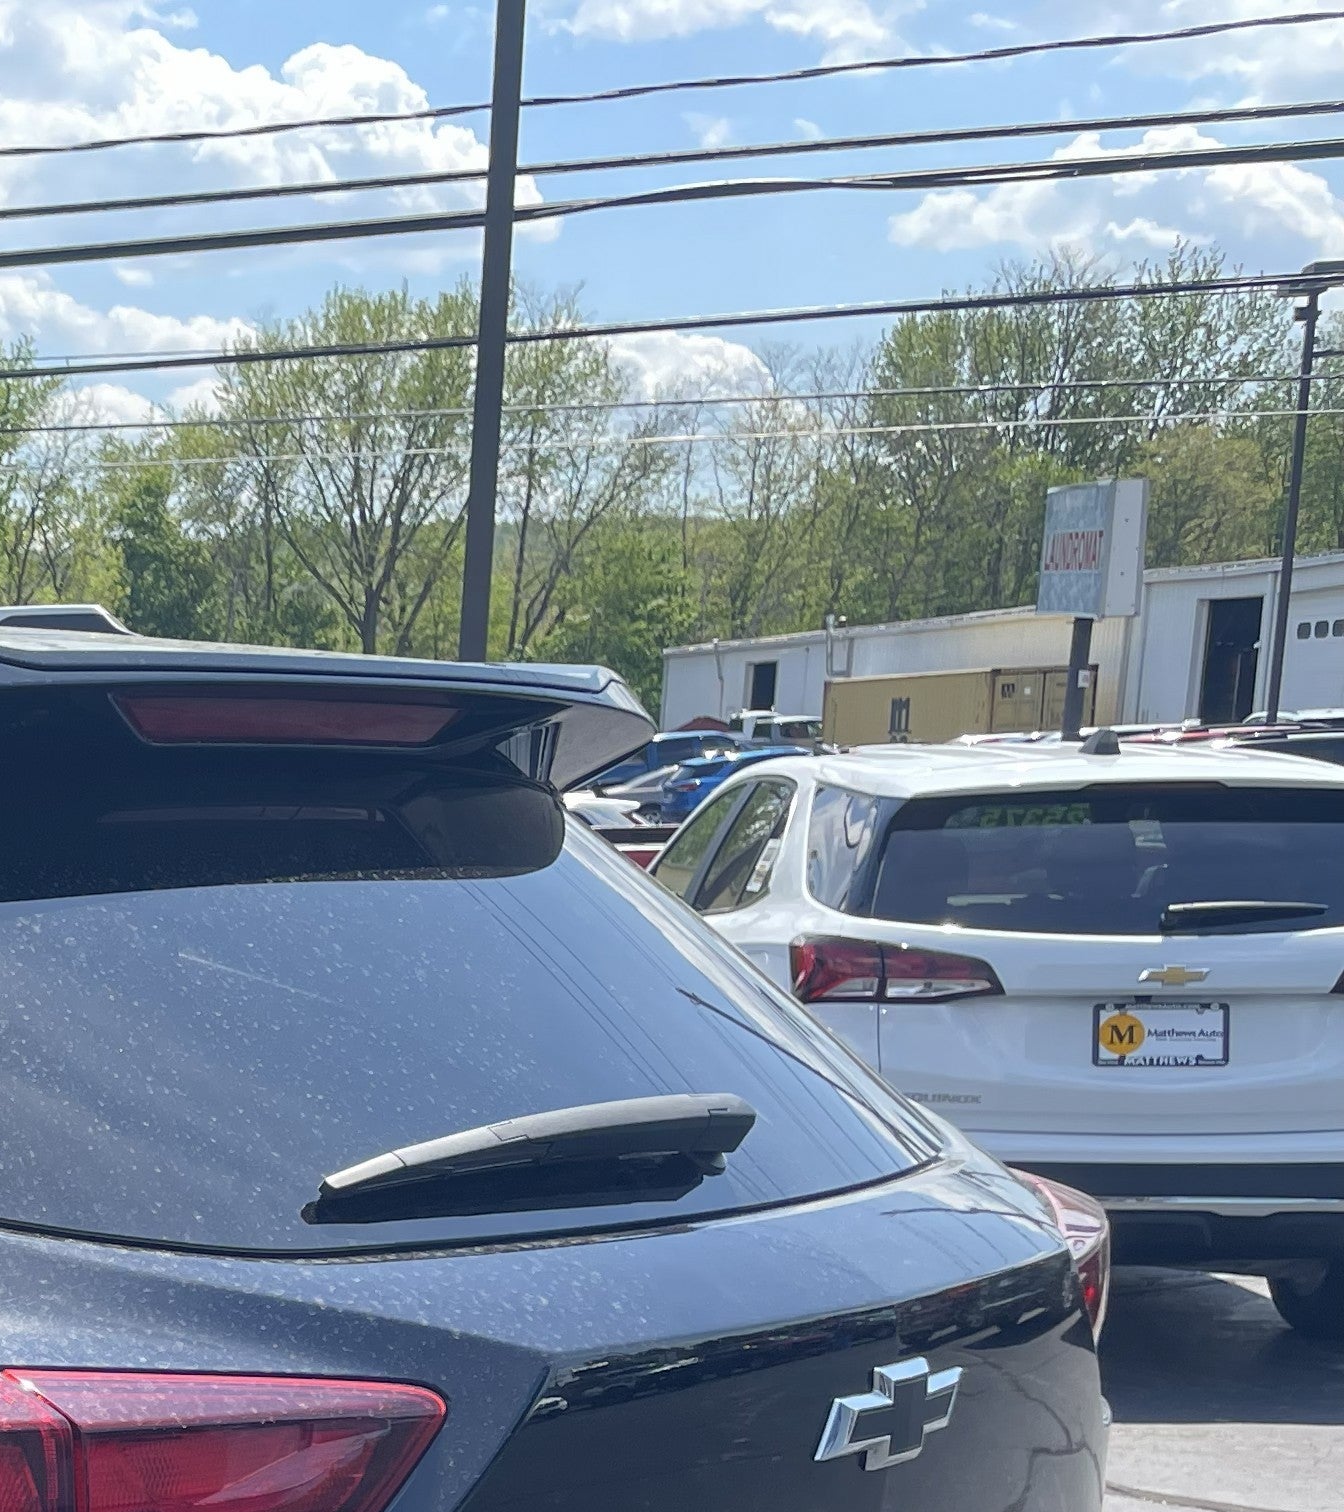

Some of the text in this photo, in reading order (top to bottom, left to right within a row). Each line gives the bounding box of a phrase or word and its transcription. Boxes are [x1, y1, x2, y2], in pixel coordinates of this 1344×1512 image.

[1044, 530, 1104, 571] LAUNDROMAT
[1107, 1024, 1224, 1045] M Matthews Auto
[1124, 1055, 1197, 1066] MATTHEWS
